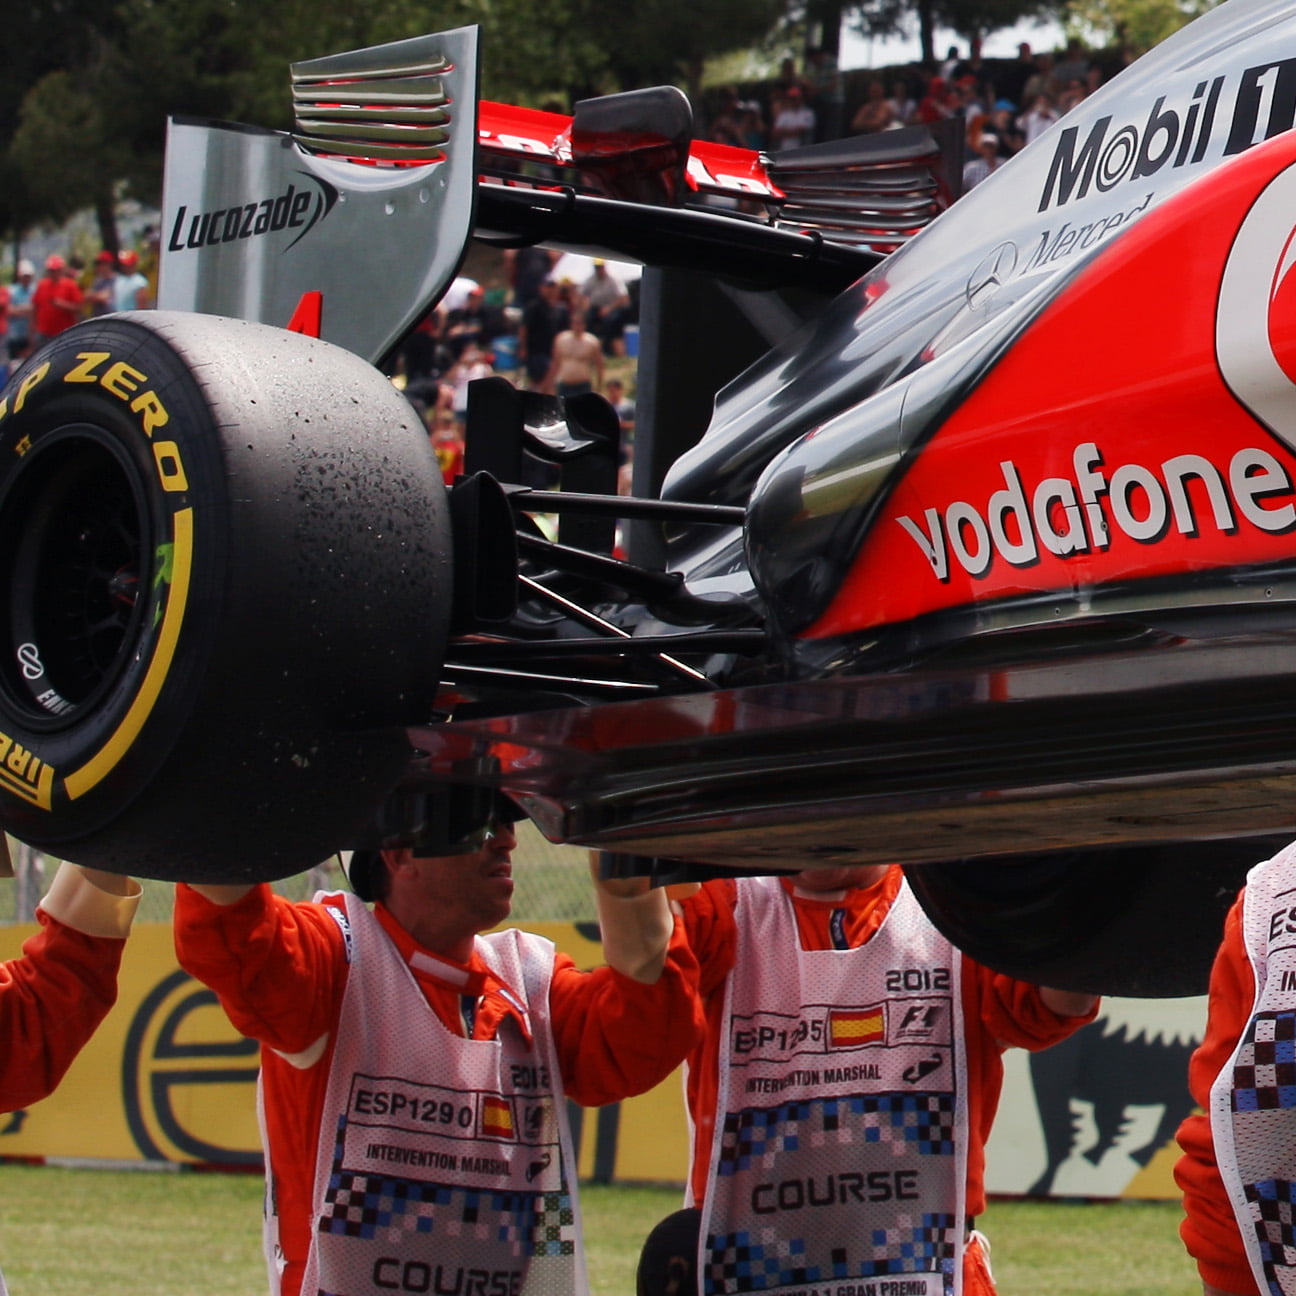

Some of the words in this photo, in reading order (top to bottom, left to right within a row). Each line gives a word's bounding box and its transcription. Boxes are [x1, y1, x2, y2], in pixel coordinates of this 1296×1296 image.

[1038, 75, 1226, 213] Mobil
[168, 184, 312, 252] Lucozade
[14, 362, 51, 414] P
[63, 352, 189, 493] ZERO
[886, 968, 951, 992] 2012
[823, 1064, 882, 1083] MARSHAL
[366, 1143, 457, 1171] INTERVENTION
[751, 1169, 919, 1215] COURSE
[880, 1279, 928, 1296] PREMIO
